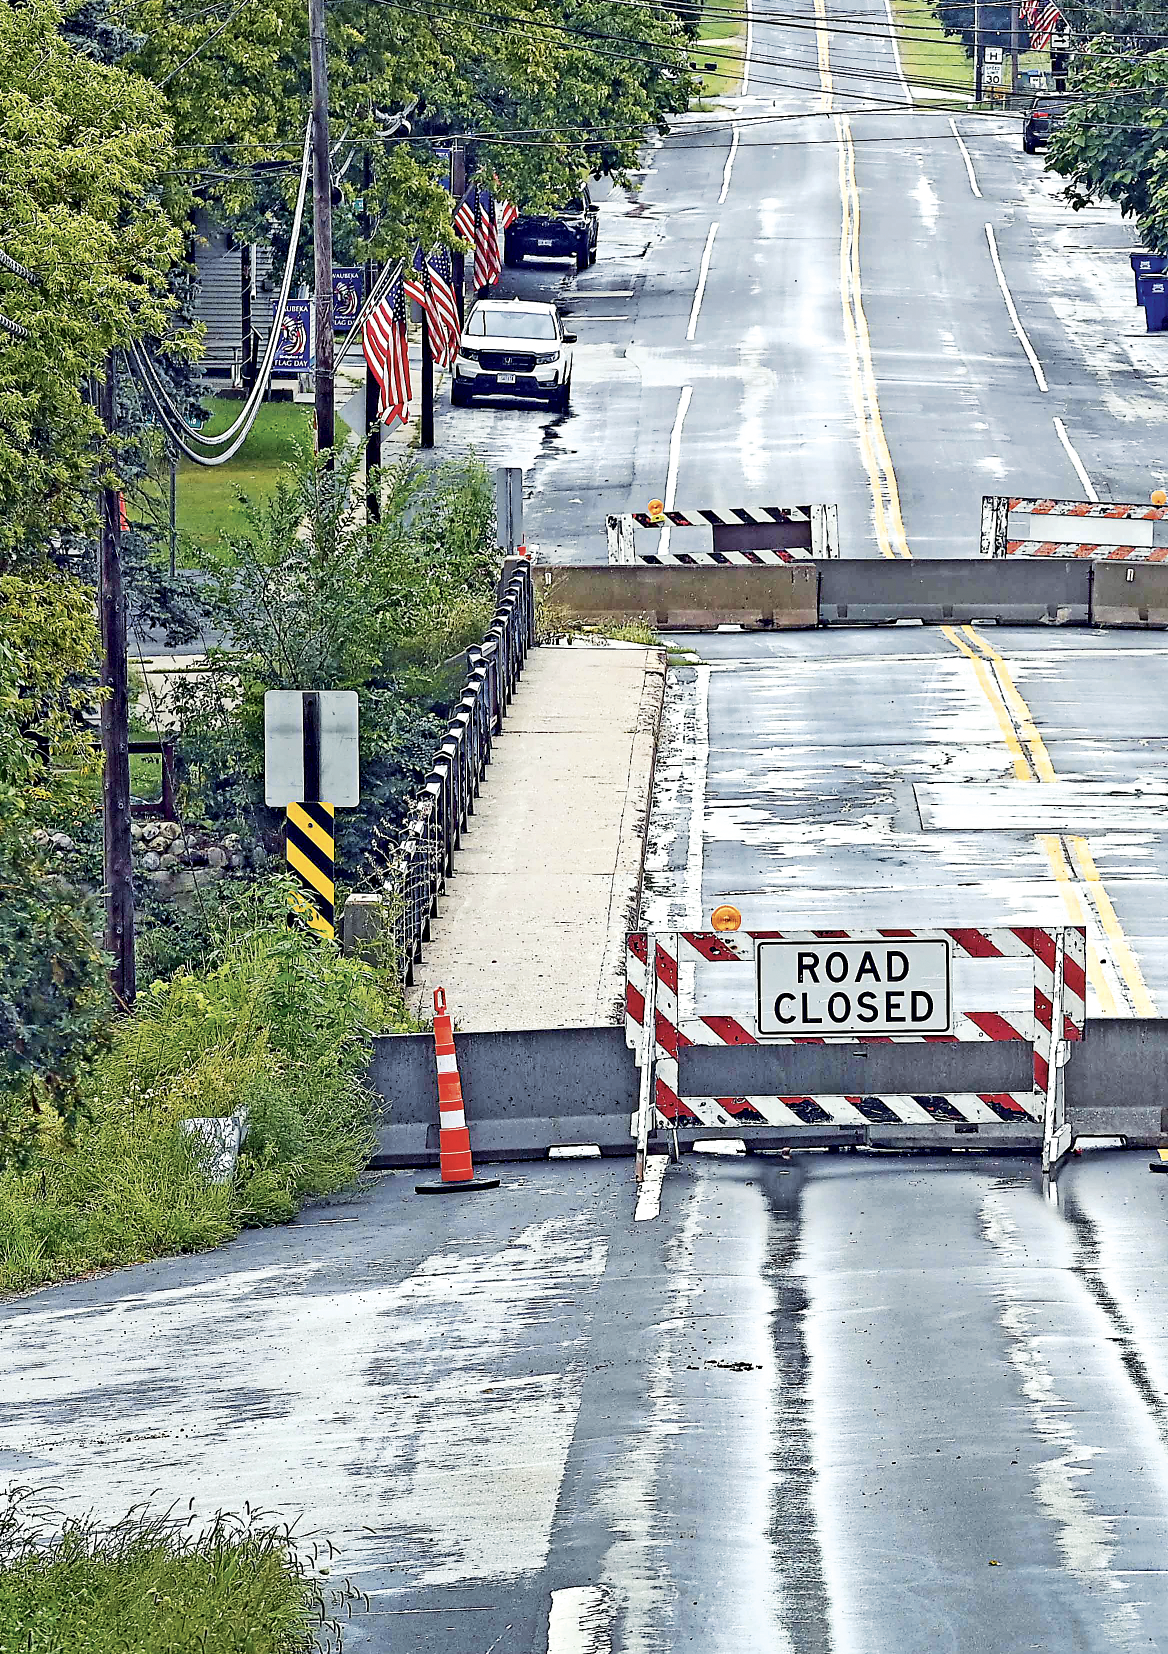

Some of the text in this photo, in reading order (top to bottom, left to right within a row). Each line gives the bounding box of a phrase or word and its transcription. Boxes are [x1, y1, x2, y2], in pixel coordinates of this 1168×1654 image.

[989, 52, 998, 61] H
[986, 75, 1000, 84] 30
[797, 950, 910, 984] ROAD
[774, 990, 934, 1024] CLOSED
